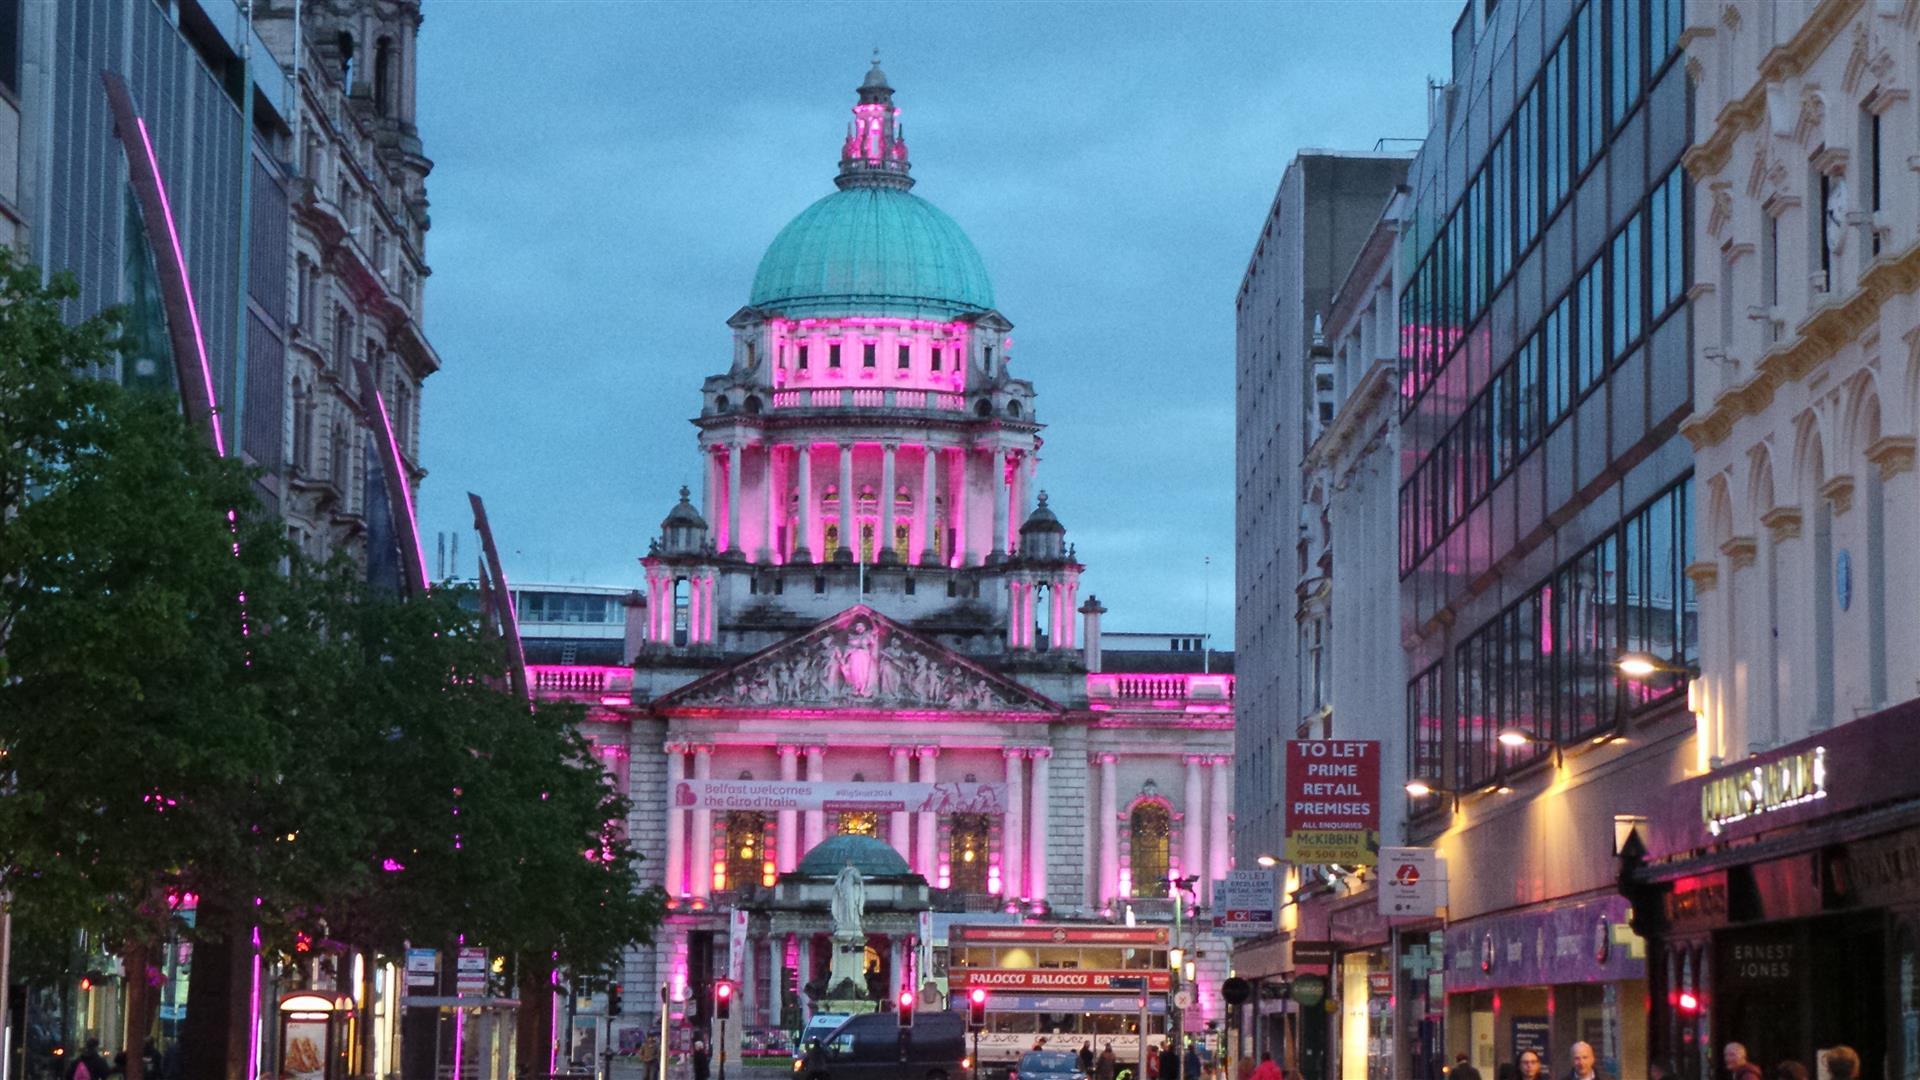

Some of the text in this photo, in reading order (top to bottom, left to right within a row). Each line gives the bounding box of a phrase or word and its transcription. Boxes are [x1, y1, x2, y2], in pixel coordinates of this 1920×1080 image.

[1298, 742, 1368, 757] TO LET
[1308, 764, 1358, 776] PRIME
[704, 784, 812, 796] Belfast welcomes
[1303, 782, 1362, 796] RETAIL
[704, 795, 724, 807] the
[726, 796, 752, 808] Giro
[1294, 803, 1370, 815] PREMISES
[1302, 821, 1363, 830] ALL ENQUIRIES
[1297, 833, 1359, 845] McKIBBIN
[1234, 871, 1265, 880] TO LET
[1735, 944, 1792, 960] ERNEST
[1740, 962, 1790, 977] JONES
[1032, 974, 1088, 985] BALOCCO
